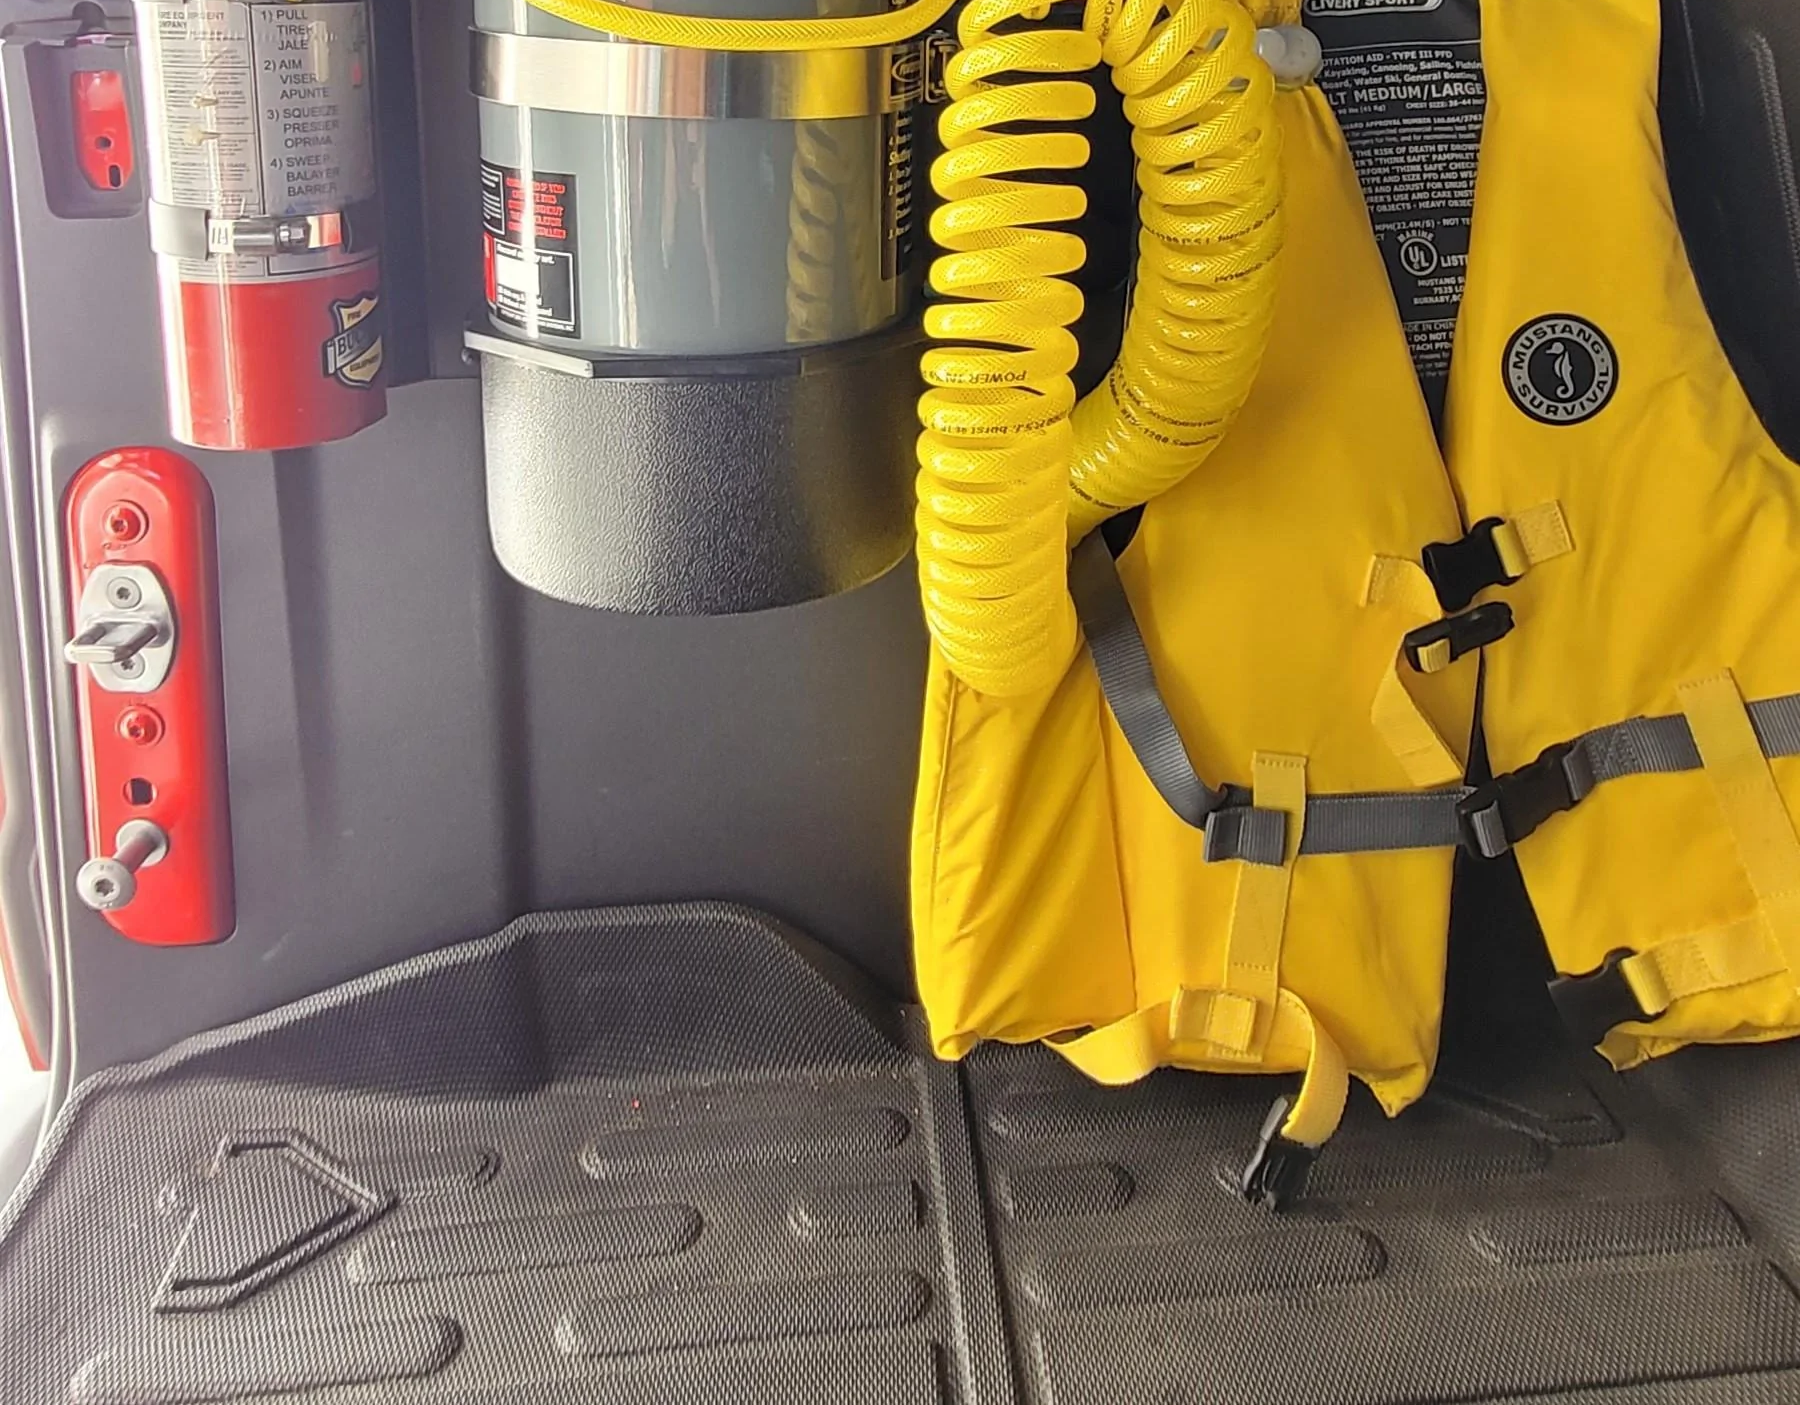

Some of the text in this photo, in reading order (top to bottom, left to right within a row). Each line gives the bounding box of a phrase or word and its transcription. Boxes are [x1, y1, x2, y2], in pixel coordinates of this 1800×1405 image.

[261, 9, 308, 22] 1) PULL
[278, 39, 309, 51] JALE
[1366, 53, 1384, 63] AID
[1392, 50, 1417, 60] TYPE
[1419, 50, 1433, 59] III
[1434, 50, 1453, 59] PFD
[264, 59, 302, 72] 2) AIM
[1324, 65, 1370, 79] Kayaking,
[1371, 62, 1418, 74] Canoeing,
[1420, 60, 1455, 70] Sailing,
[280, 73, 318, 85] VISER
[1353, 77, 1382, 86] Water
[1384, 74, 1402, 83] Ski,
[1404, 71, 1441, 83] General
[1443, 71, 1477, 81] Boating
[280, 87, 330, 100] APUNTE
[1353, 82, 1485, 103] MEDIUM/LARGE
[267, 105, 339, 122] 3) SQUEEZE
[283, 120, 340, 134] PRESSER
[284, 135, 333, 149] OPRIMA
[1355, 150, 1371, 158] THE
[1373, 148, 1394, 156] RISK
[1395, 147, 1406, 155] OF
[1408, 145, 1436, 154] DEATH
[1437, 144, 1449, 152] BY
[1431, 152, 1475, 163] PAMPHLET
[270, 154, 331, 170] 4) SWEEP
[286, 167, 340, 182] BALAYER
[1361, 176, 1381, 185] TYPE
[1383, 175, 1401, 183] AND
[1402, 173, 1421, 182] SIZE
[1422, 172, 1439, 181] PFD
[1440, 171, 1458, 180] AND
[287, 182, 337, 197] BARRER
[1375, 185, 1392, 194] AND
[1393, 182, 1425, 192] ADJUST
[1426, 181, 1443, 190] FOR
[1393, 193, 1410, 202] USE
[1411, 192, 1430, 201] AND
[1431, 191, 1452, 199] CARE
[1376, 203, 1412, 212] OBJECTS
[1418, 200, 1446, 209] HEAVY
[1442, 217, 1459, 226] NOT
[1396, 229, 1434, 243] MARINE
[1417, 277, 1457, 287] MUSTANG
[1422, 323, 1432, 331] IN
[1414, 334, 1428, 343] DO
[1429, 332, 1447, 342] NOT
[1513, 324, 1603, 370] MUSTANG
[968, 370, 1027, 384] POWER
[1517, 365, 1609, 416] SURVIVAL
[970, 425, 1007, 436] burst
